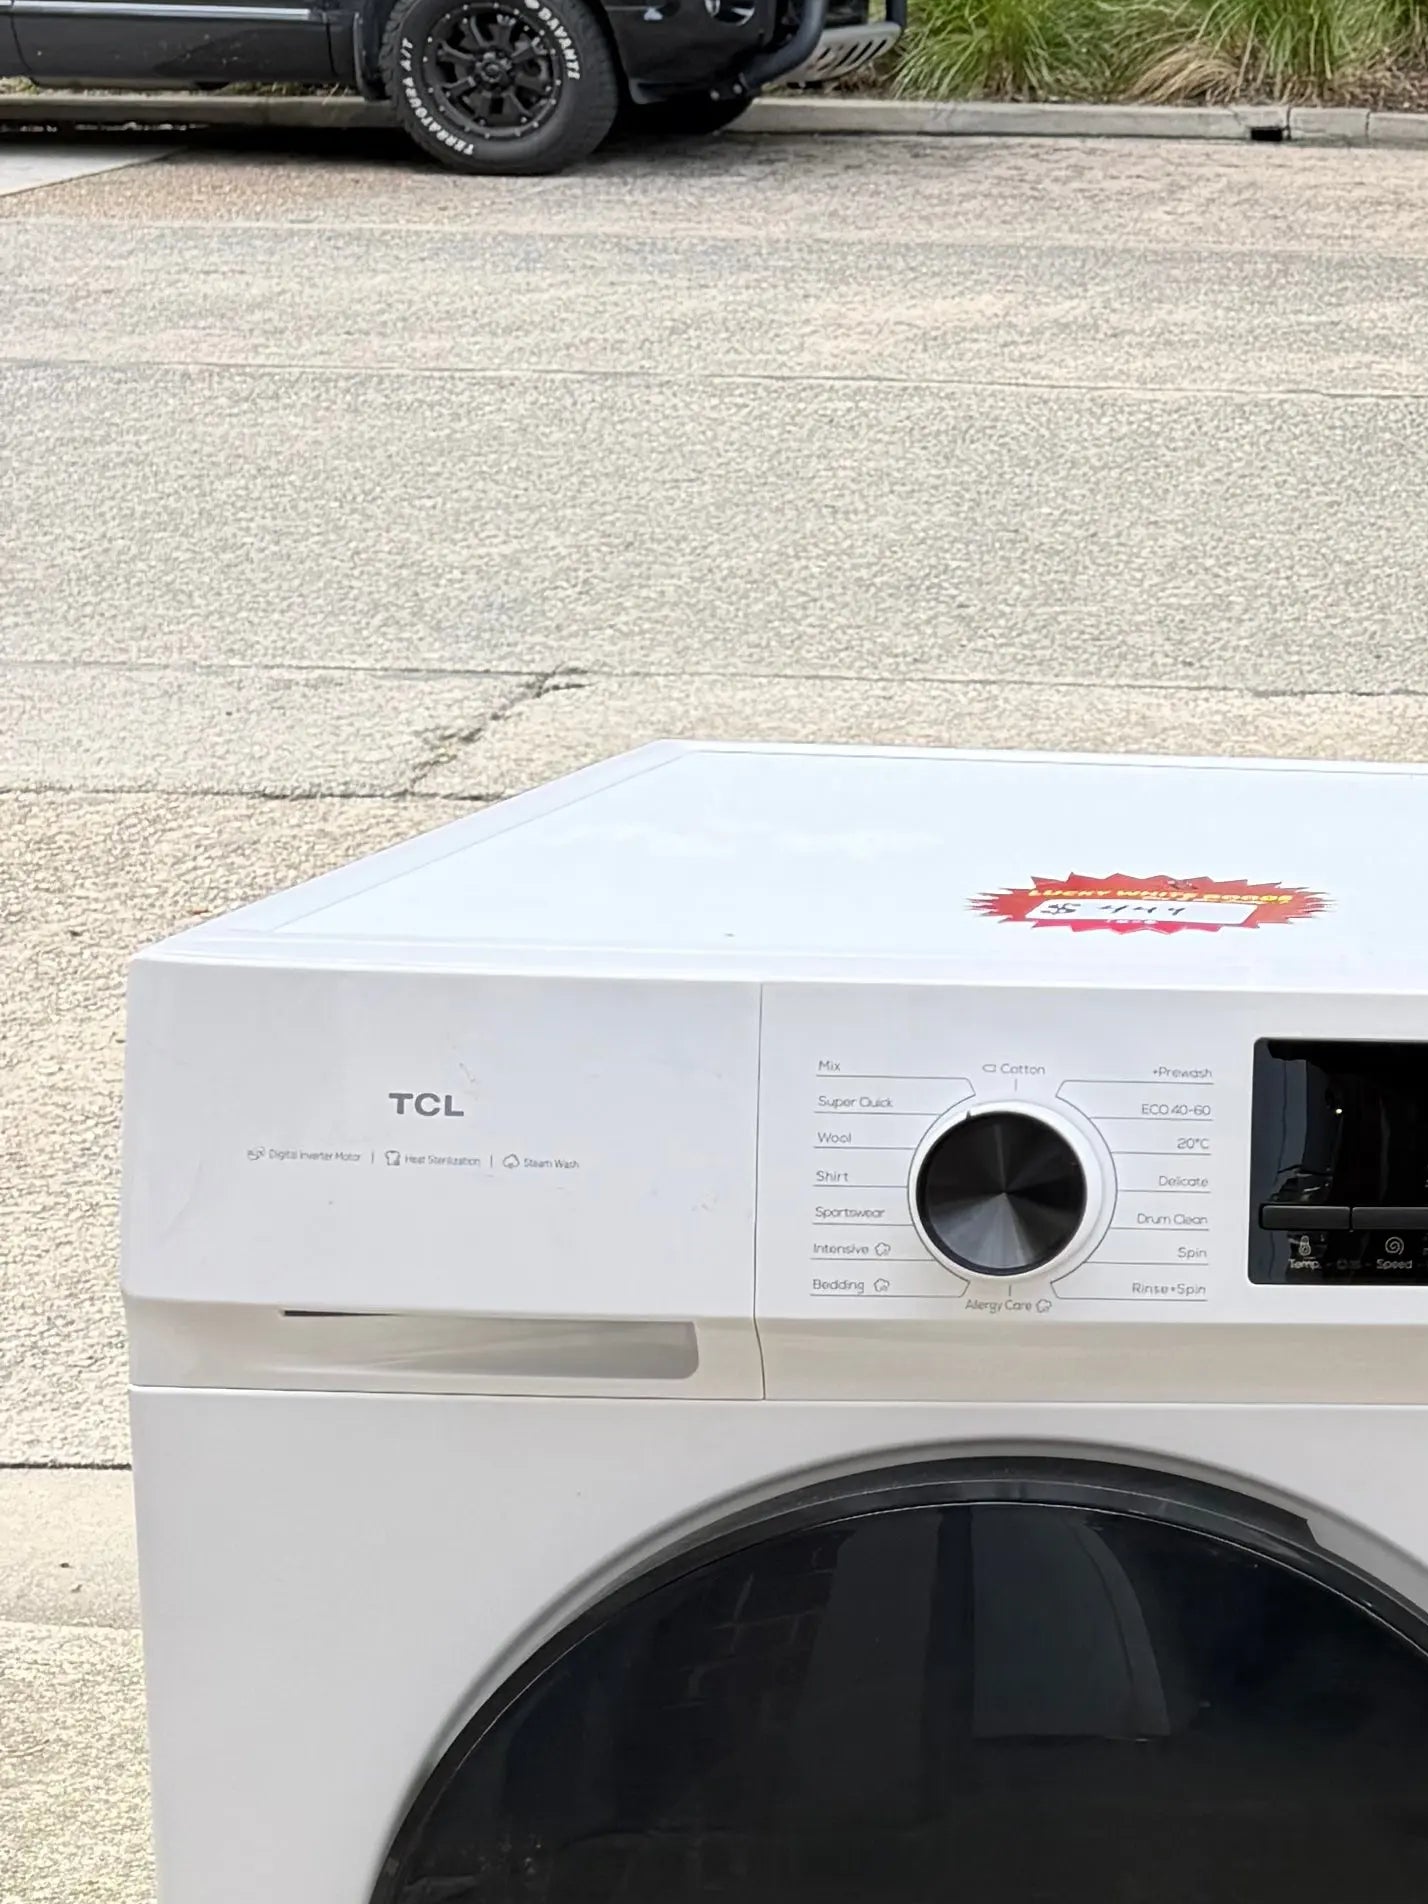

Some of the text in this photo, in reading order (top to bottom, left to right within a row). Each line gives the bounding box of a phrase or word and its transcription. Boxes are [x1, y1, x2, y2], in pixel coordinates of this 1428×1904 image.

[818, 1059, 841, 1072] Mix
[1000, 1062, 1046, 1075] Cotton
[388, 1092, 465, 1117] TCL
[818, 1095, 894, 1109] Super Quick
[1141, 1103, 1212, 1116] ECO 40-60
[817, 1132, 852, 1144] Wool
[1176, 1137, 1210, 1150] 20°C
[554, 1159, 580, 1170] Wash
[816, 1170, 849, 1183] Shirt
[1158, 1175, 1209, 1187] Delicate
[815, 1206, 886, 1219] Sportswear
[1137, 1212, 1209, 1225] Drum Clean
[812, 1243, 870, 1255] Intensive
[1177, 1246, 1208, 1260] Spin
[1376, 1258, 1414, 1271] Speed
[812, 1279, 865, 1295] Bedding
[1004, 1299, 1033, 1312] Care
